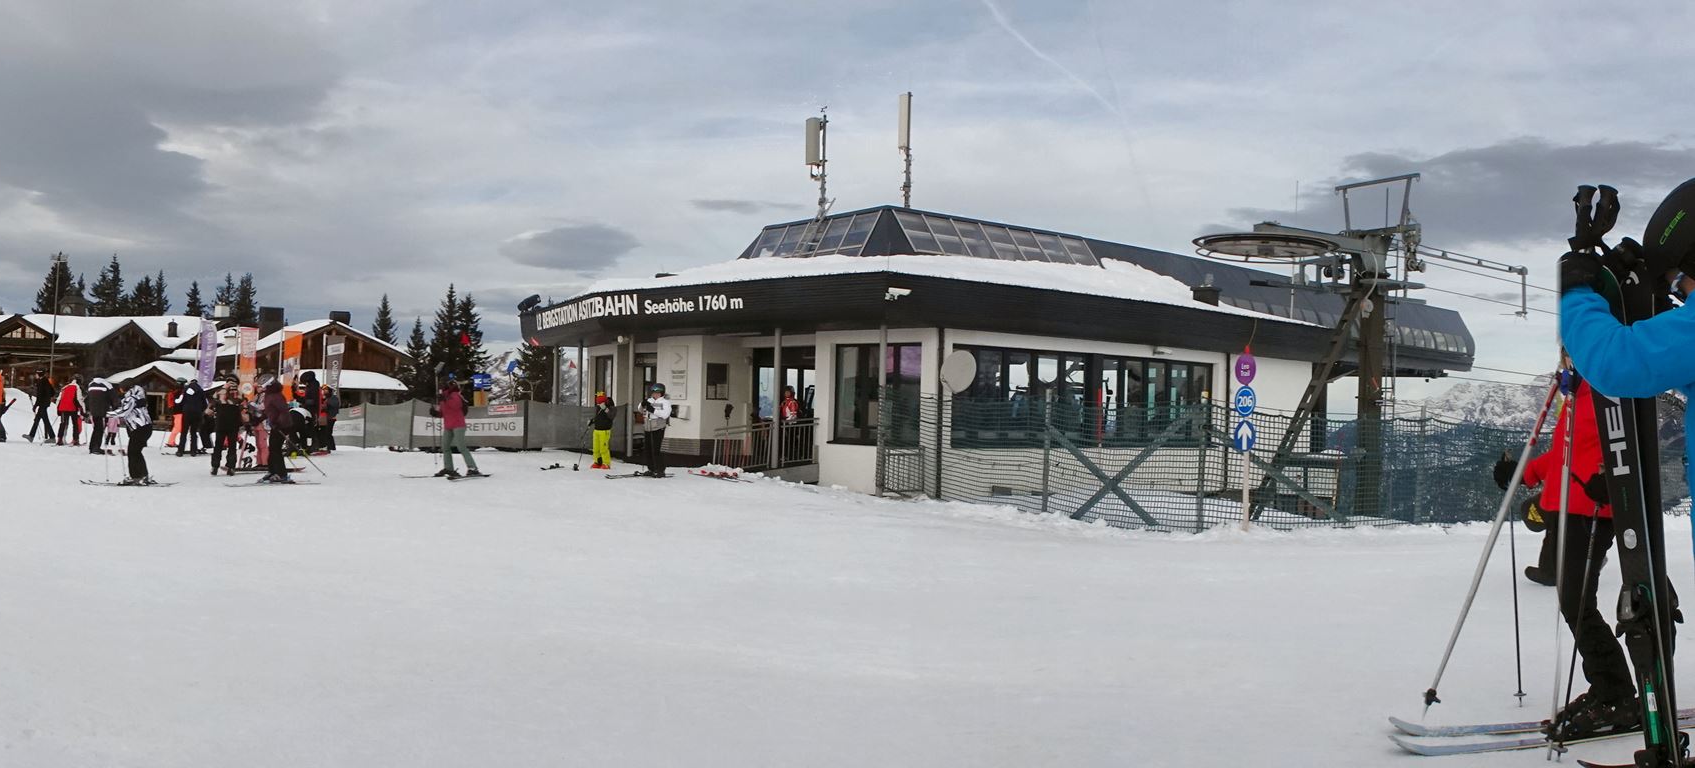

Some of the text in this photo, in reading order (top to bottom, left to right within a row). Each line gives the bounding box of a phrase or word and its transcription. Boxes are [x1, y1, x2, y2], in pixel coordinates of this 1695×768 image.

[542, 302, 578, 330] BERGSTATION
[578, 294, 638, 321] ASITZBAHN
[644, 298, 695, 315] Seehöhe
[699, 294, 727, 311] 1760
[729, 297, 743, 309] m
[1238, 396, 1253, 407] 206
[1605, 397, 1631, 477] HE
